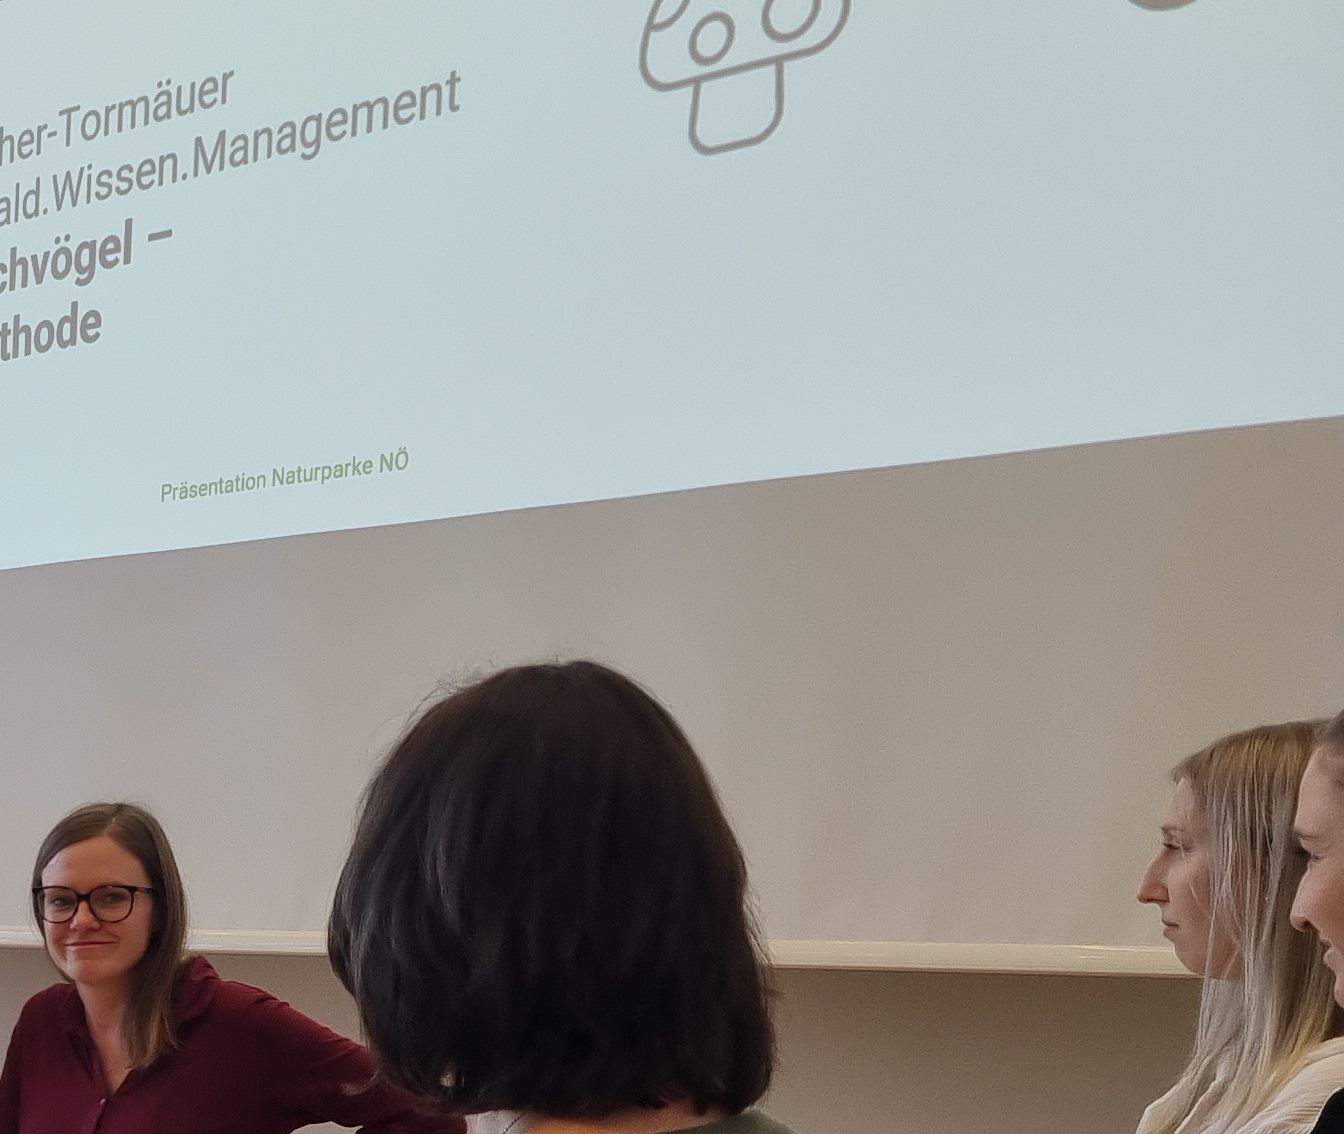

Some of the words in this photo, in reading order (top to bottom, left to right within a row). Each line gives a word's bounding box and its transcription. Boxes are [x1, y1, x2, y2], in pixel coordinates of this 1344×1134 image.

[161, 473, 266, 502] Präsentation
[272, 456, 373, 487] Naturparke
[379, 446, 410, 473] NÖ
